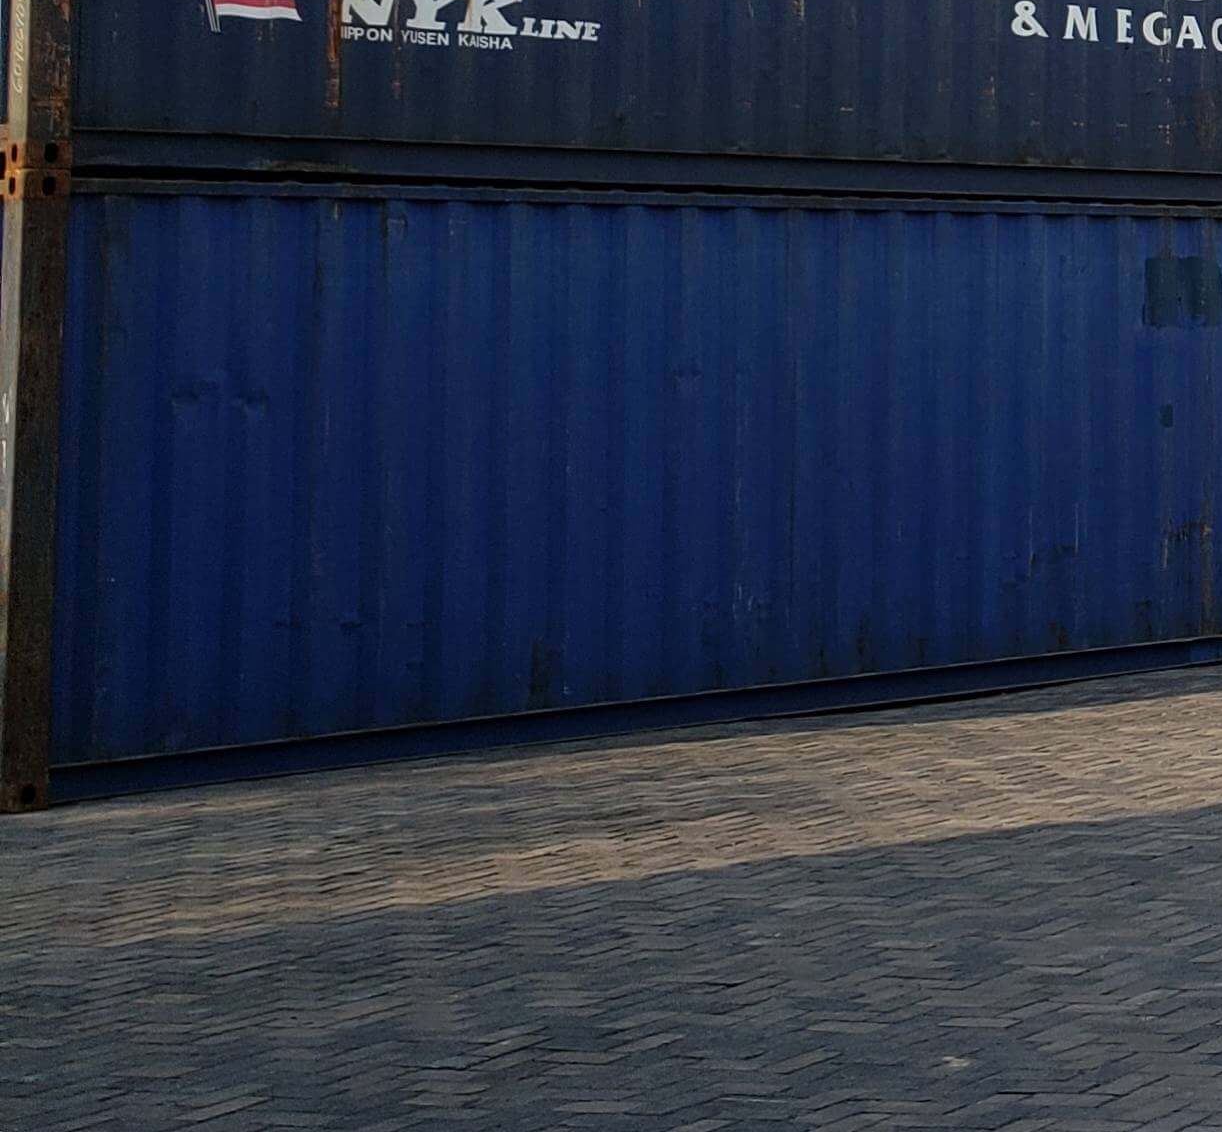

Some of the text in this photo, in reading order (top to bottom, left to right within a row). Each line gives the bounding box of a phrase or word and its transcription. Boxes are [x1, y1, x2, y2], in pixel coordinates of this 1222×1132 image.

[520, 17, 600, 42] LINE
[1011, 0, 1049, 37] &
[401, 31, 450, 47] YUSEN
[458, 33, 514, 50] KAISHA
